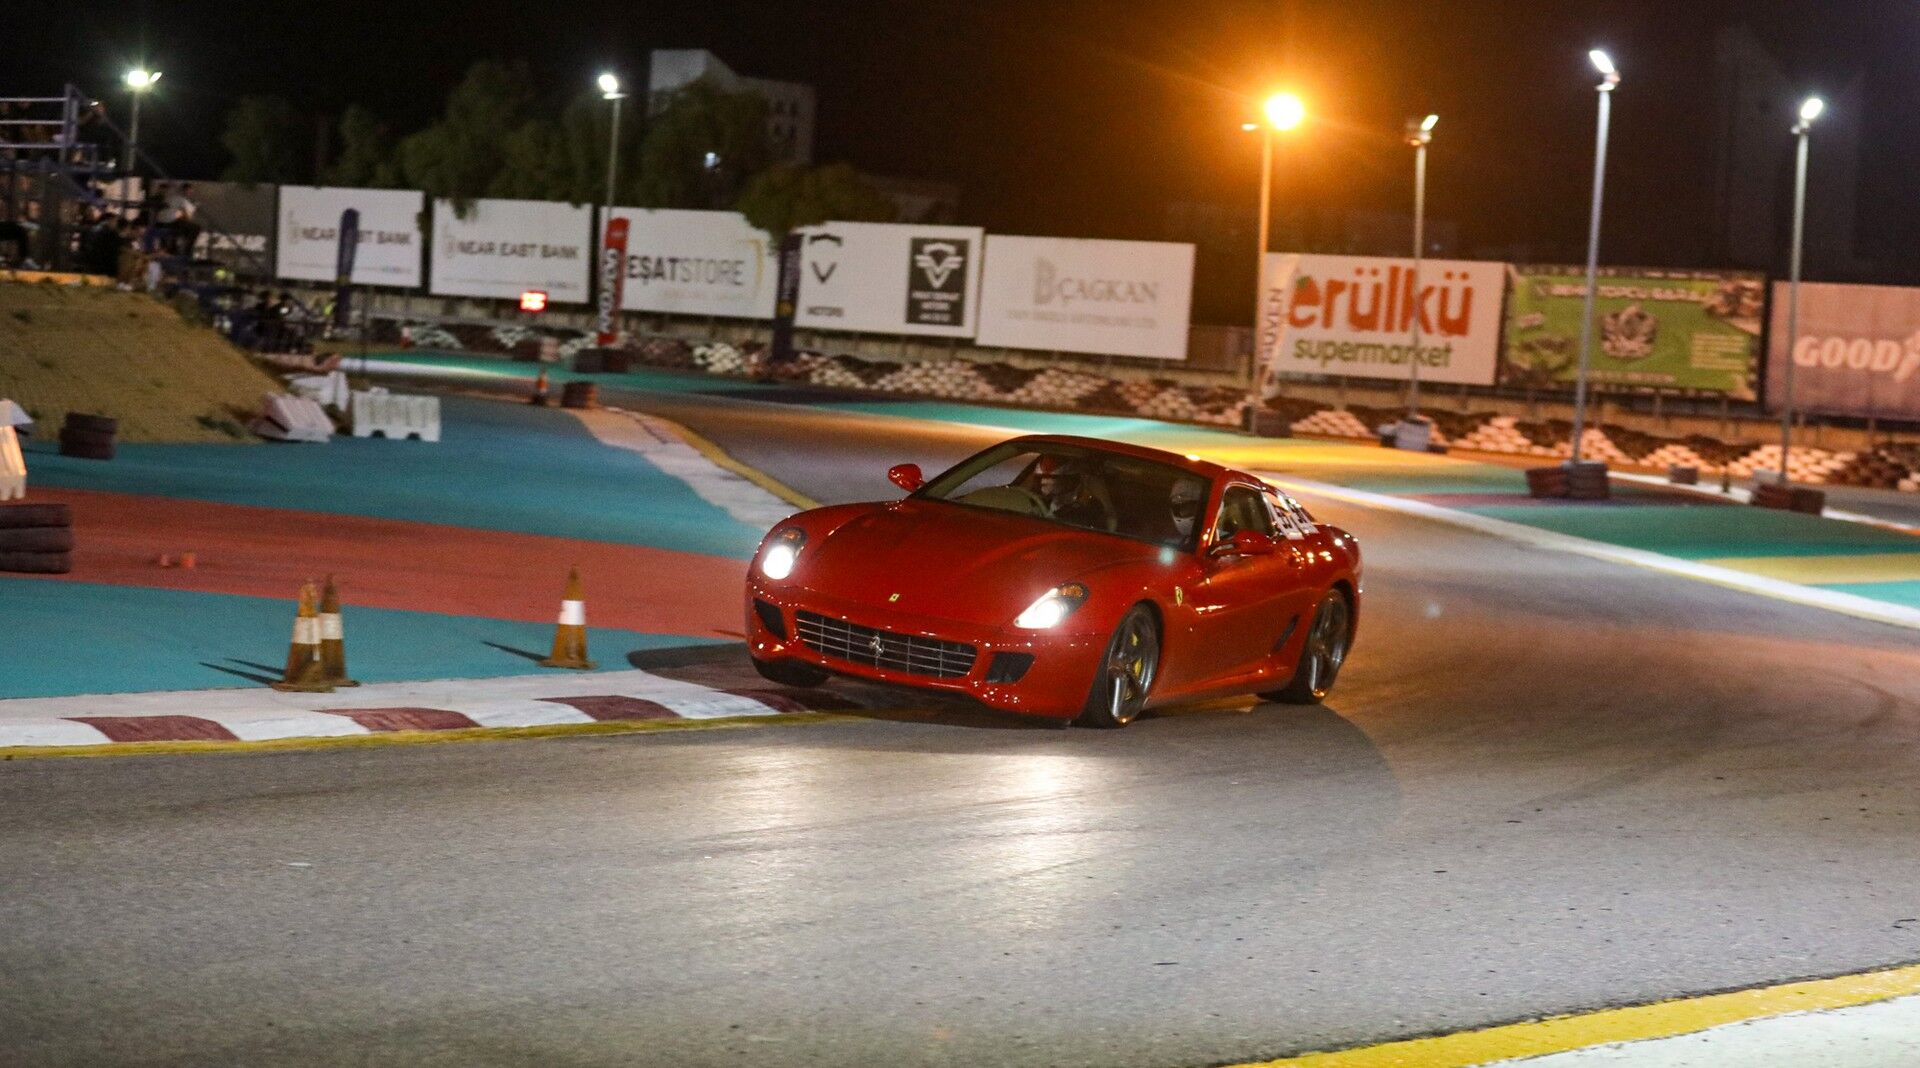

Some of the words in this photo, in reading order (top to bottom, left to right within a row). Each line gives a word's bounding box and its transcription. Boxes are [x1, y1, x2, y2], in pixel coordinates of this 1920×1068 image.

[302, 227, 336, 241] NEAR
[458, 241, 495, 256] NEAR
[500, 242, 537, 258] EAST
[541, 244, 578, 259] BANK
[1292, 337, 1453, 369] supermarket
